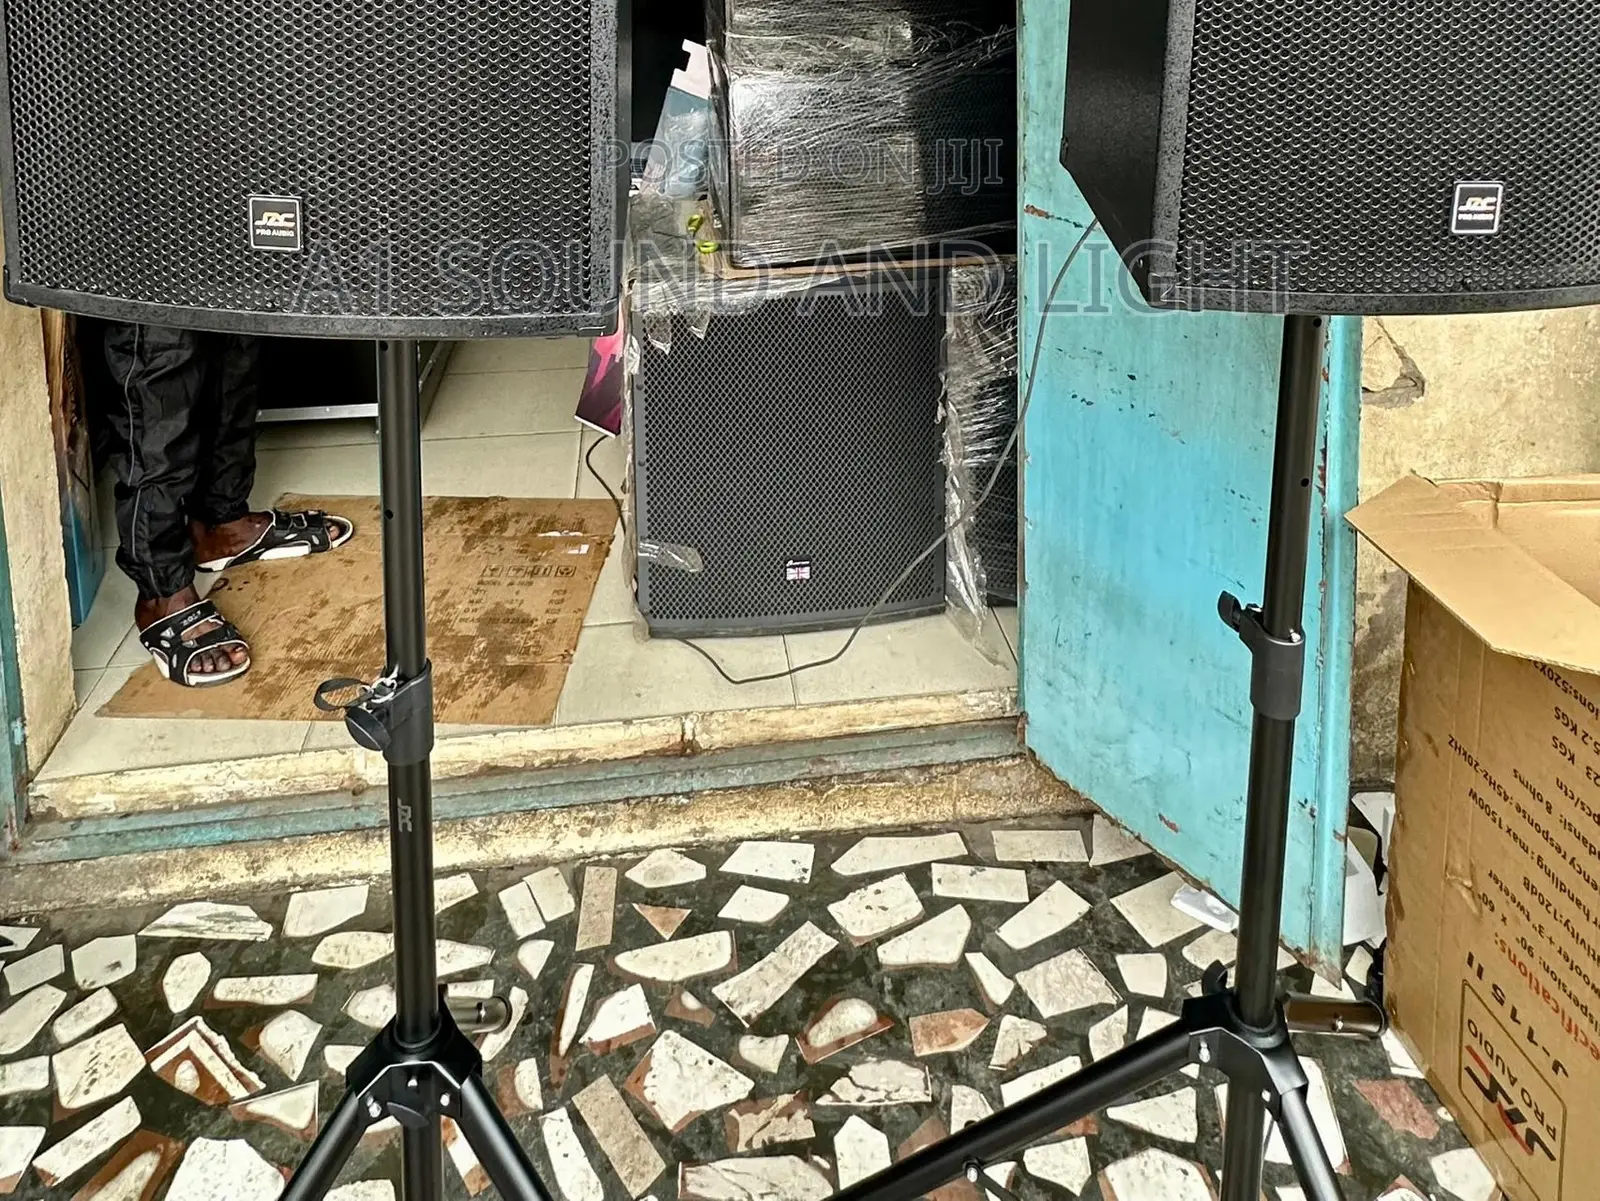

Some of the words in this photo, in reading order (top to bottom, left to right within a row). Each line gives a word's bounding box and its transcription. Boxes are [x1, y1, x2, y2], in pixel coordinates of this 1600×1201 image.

[1554, 706, 1578, 737] KGS
[1551, 736, 1575, 767] KGS
[1513, 768, 1544, 803] ohms
[1468, 787, 1503, 830] 1500W
[1545, 800, 1553, 815] 8
[1506, 825, 1529, 854] max
[1488, 869, 1530, 922] tweeter
[1467, 1018, 1519, 1088] AUDIO
[1520, 1086, 1557, 1142] PRO
